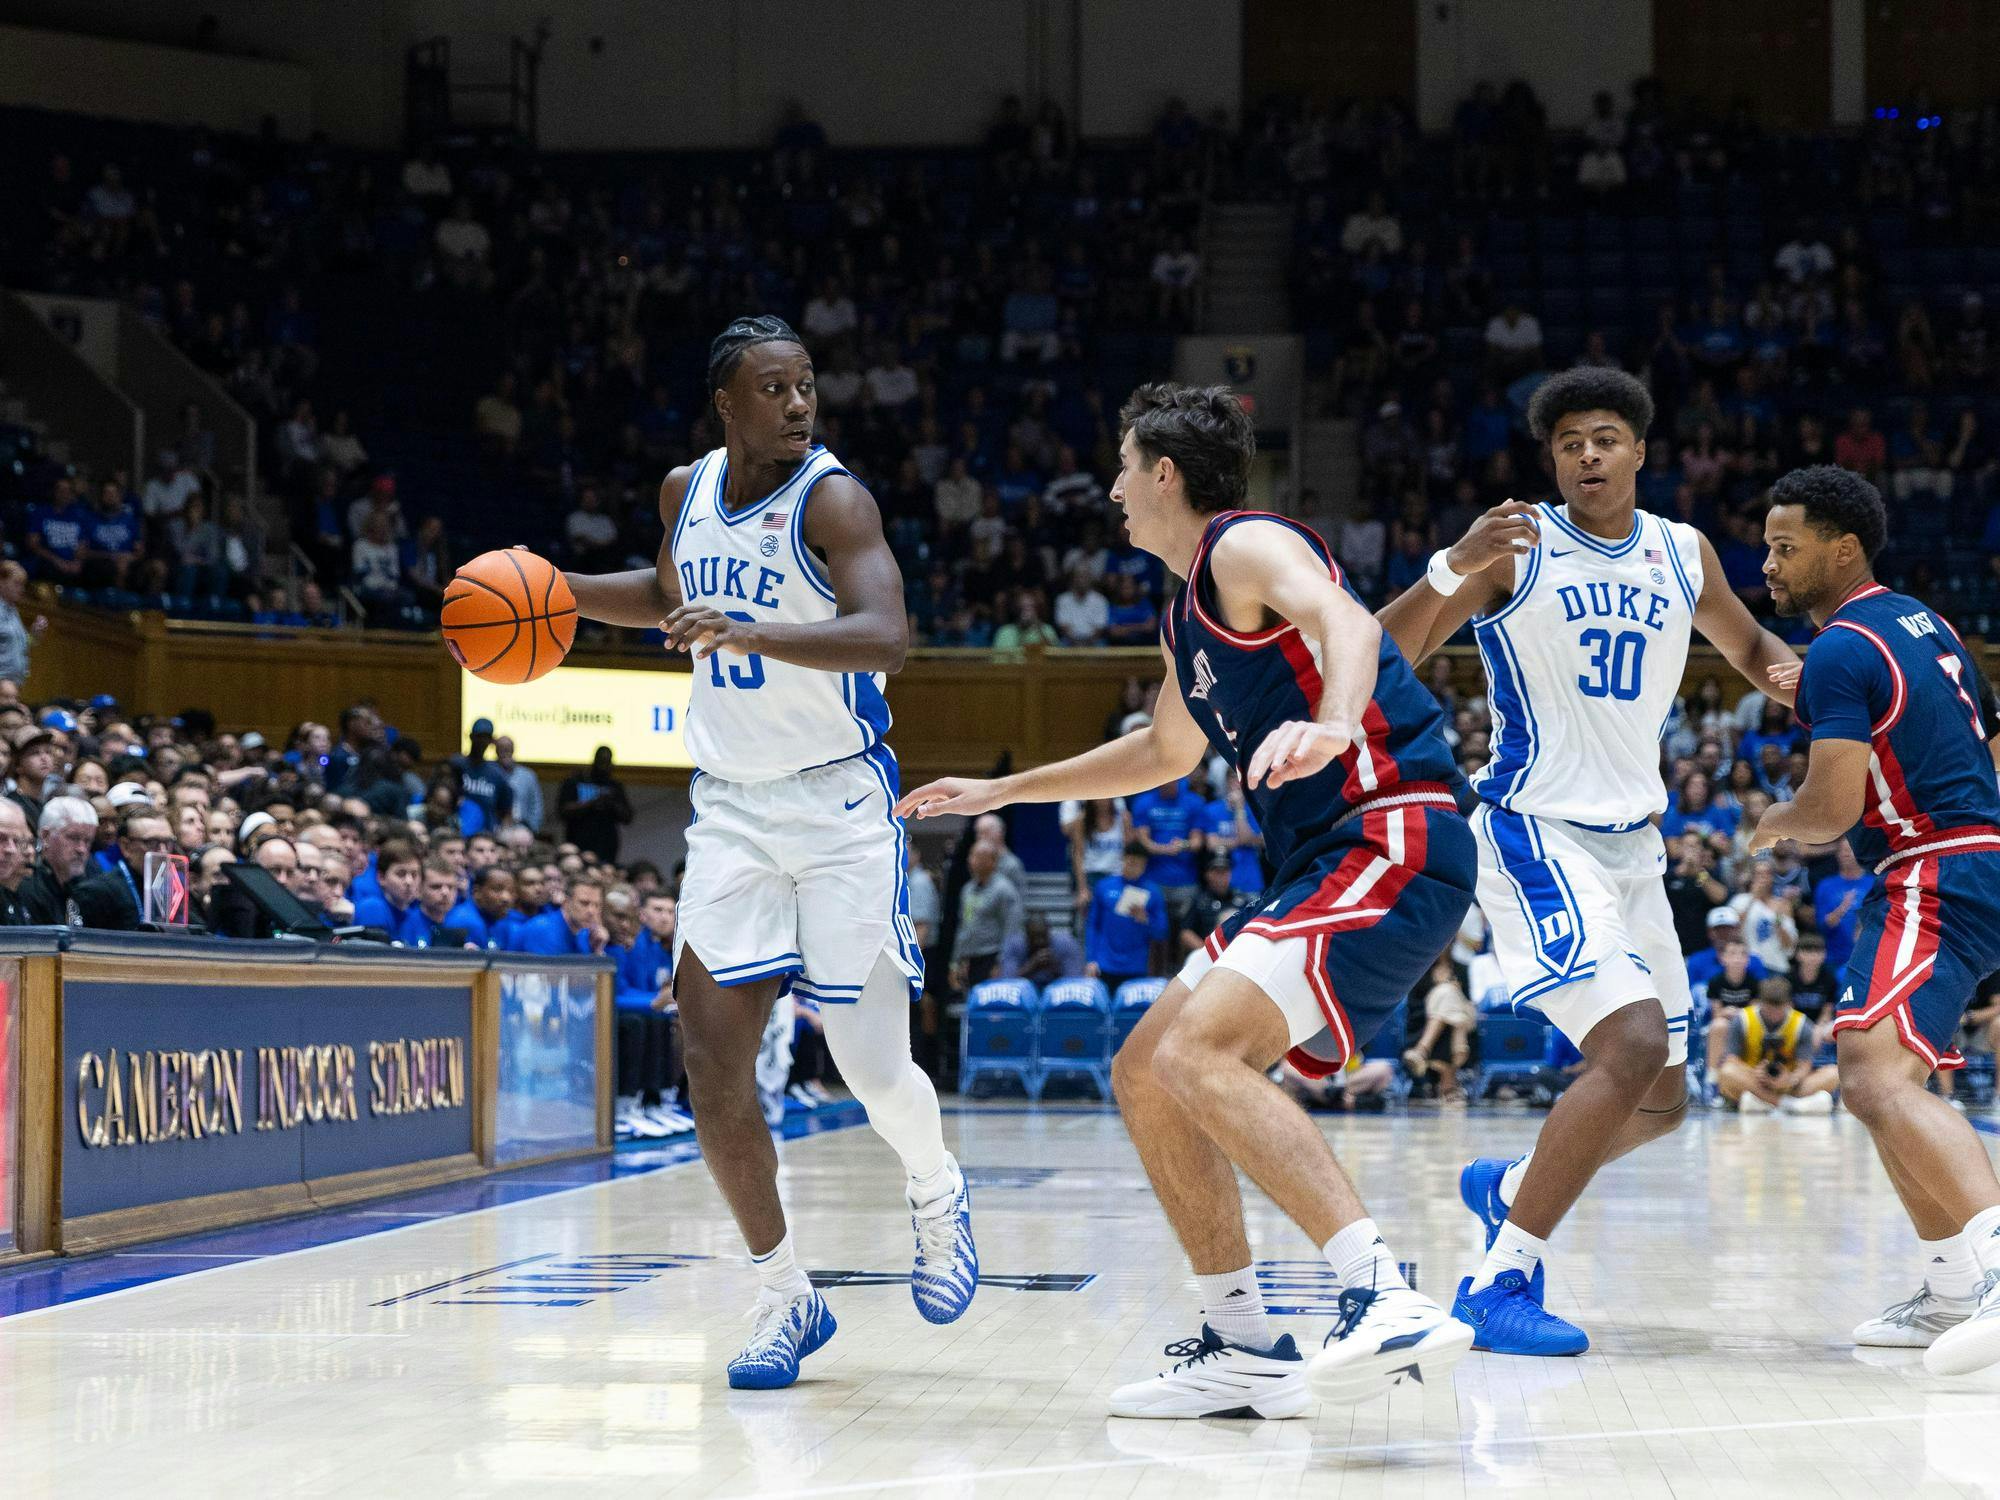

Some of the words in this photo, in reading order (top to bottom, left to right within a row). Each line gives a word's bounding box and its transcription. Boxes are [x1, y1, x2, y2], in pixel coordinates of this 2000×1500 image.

[680, 556, 785, 609] DUKE
[1556, 582, 1670, 631] DUKE
[1578, 628, 1647, 701] 30
[1540, 910, 1571, 945] D
[78, 1047, 243, 1149] CAMERON
[255, 1044, 358, 1131] INDOOR
[369, 1037, 465, 1115] STADIUM
